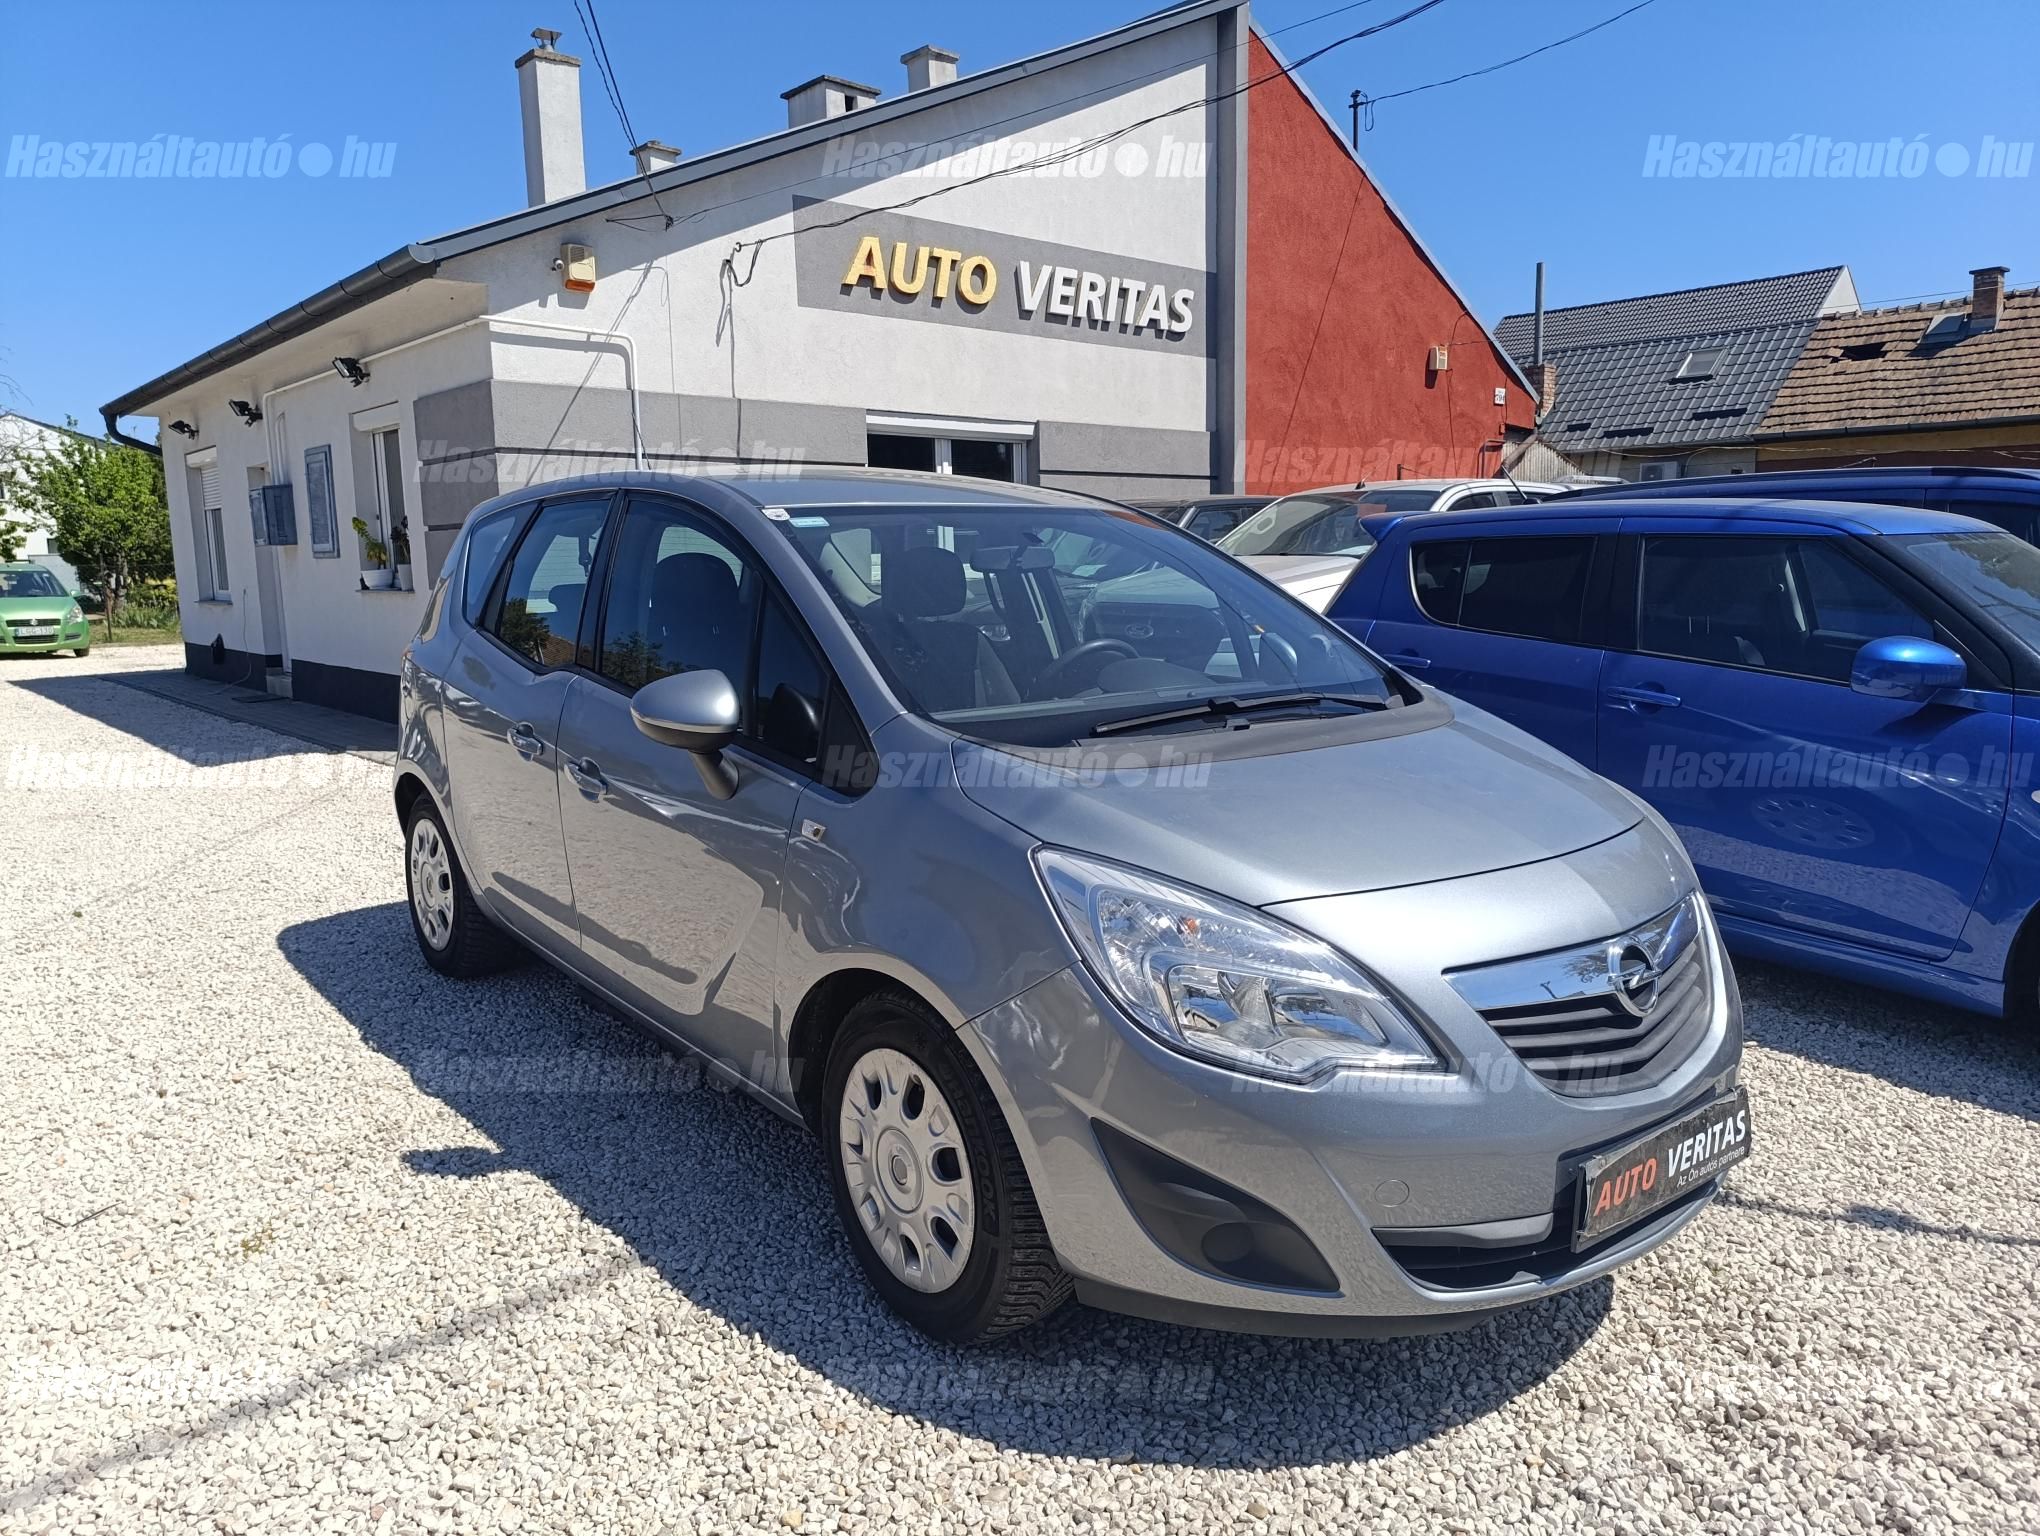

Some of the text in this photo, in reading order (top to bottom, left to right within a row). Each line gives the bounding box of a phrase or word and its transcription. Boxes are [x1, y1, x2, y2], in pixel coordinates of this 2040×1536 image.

[843, 236, 1195, 334] AUTO VERITAS
[1594, 1110, 1746, 1216] AUTO VERITAS
[1677, 1175, 1687, 1188] Az
[1718, 1146, 1745, 1169] partnere
